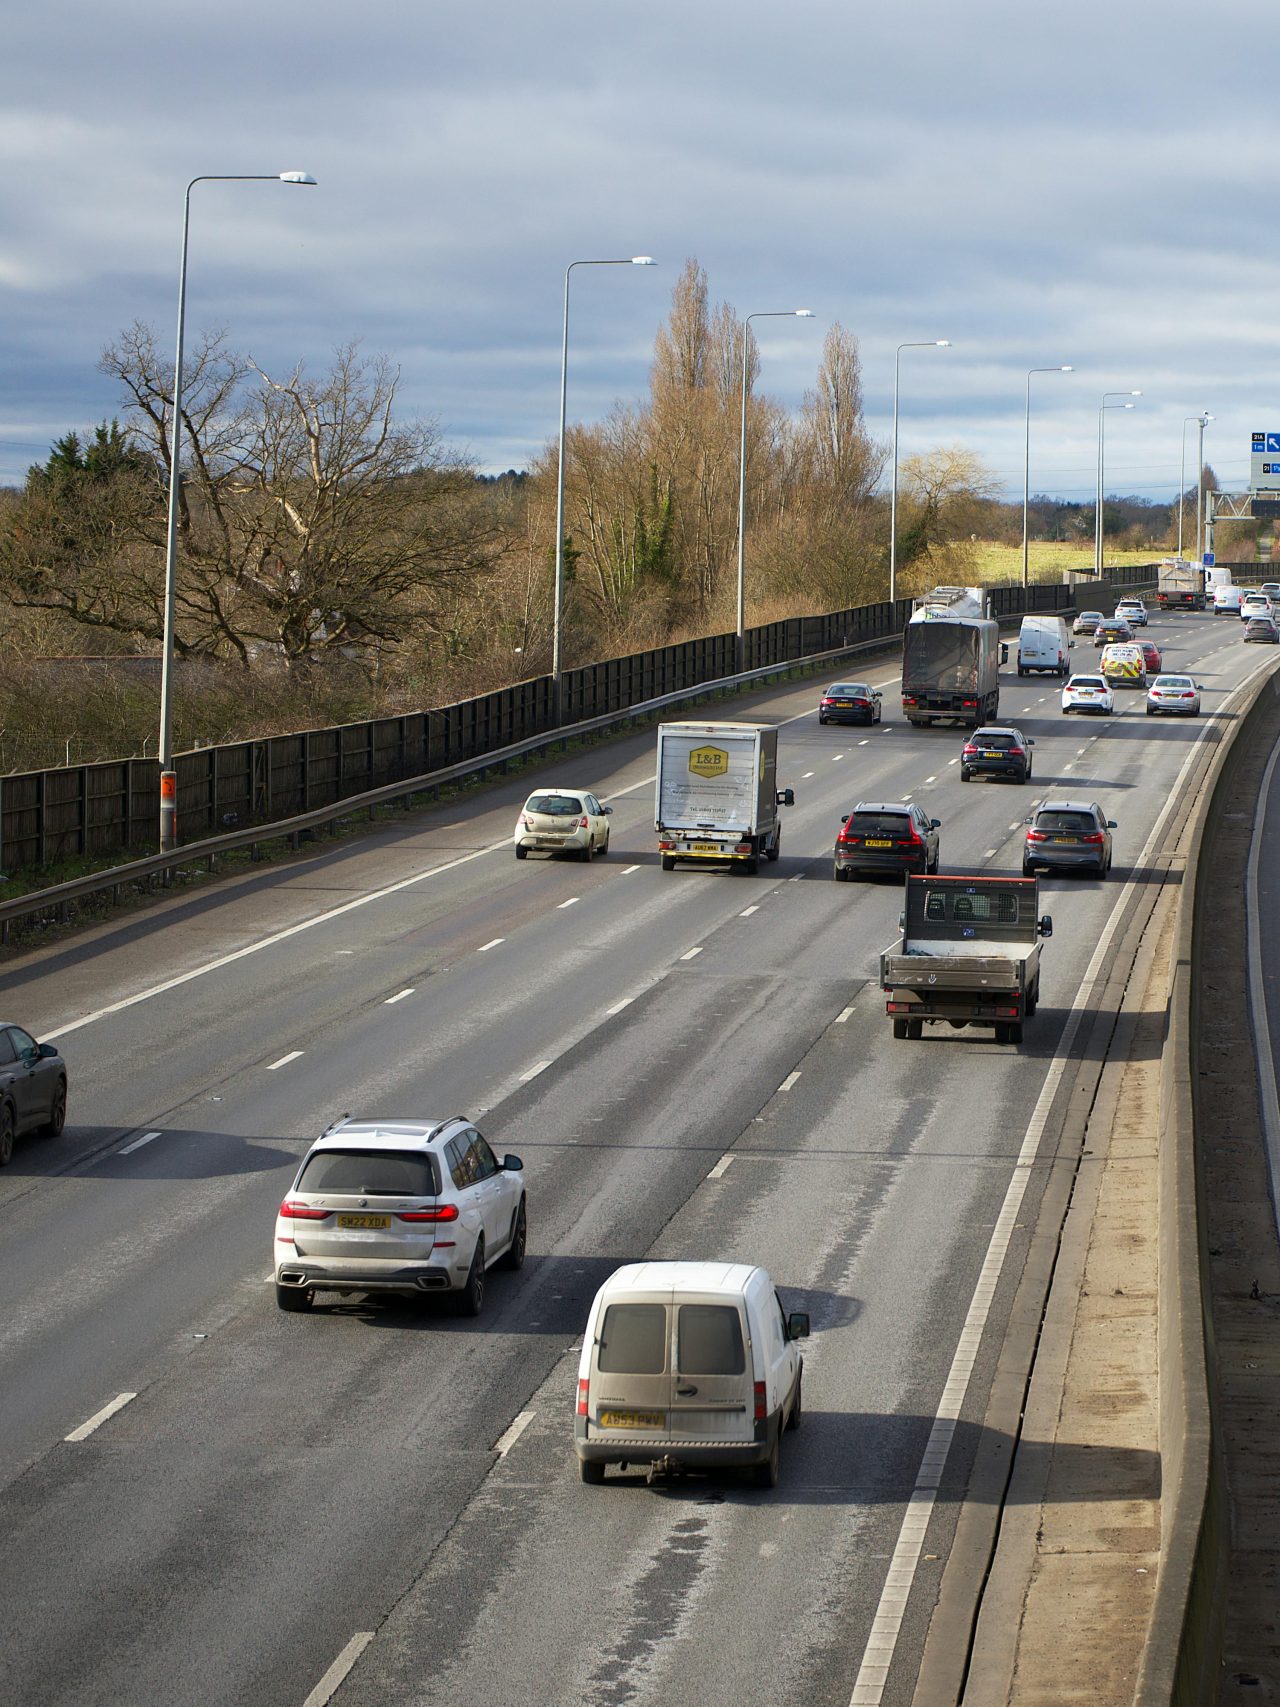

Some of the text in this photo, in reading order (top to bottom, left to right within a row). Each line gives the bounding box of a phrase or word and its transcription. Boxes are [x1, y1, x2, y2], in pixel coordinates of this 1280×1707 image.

[695, 753, 722, 765] L&B
[341, 1216, 387, 1227] SM22 XDA
